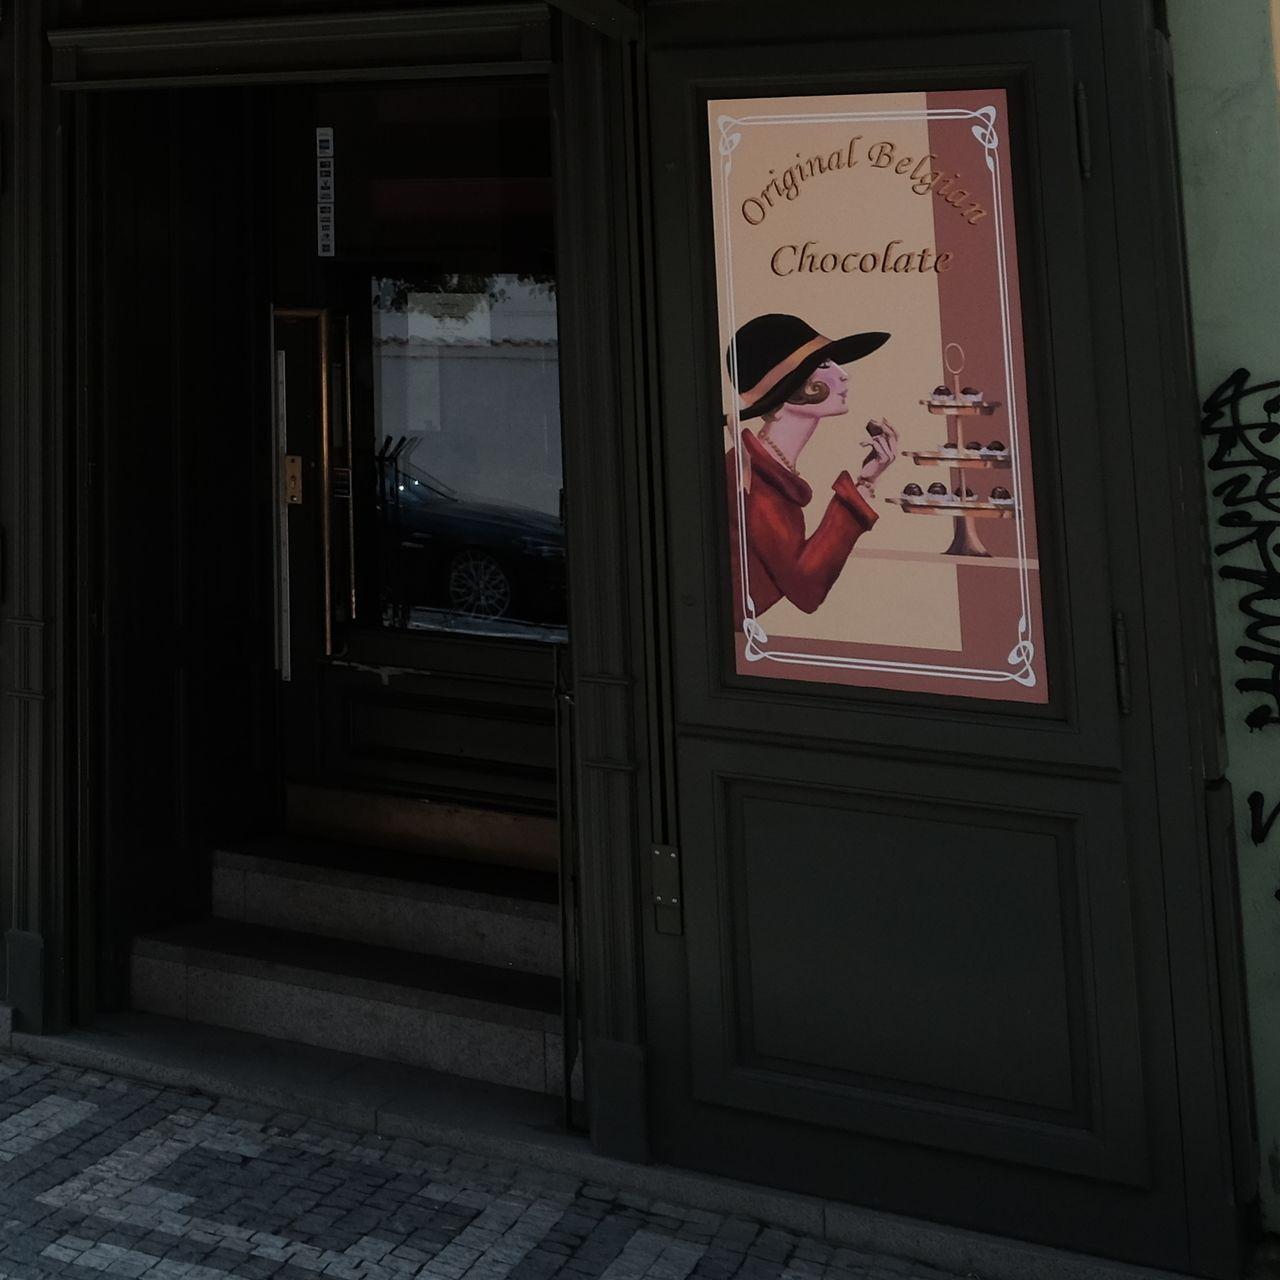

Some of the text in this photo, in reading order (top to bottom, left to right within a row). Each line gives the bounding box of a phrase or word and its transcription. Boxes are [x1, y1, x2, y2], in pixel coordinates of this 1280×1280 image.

[741, 135, 988, 226] Original Belgian
[770, 239, 954, 278] Chocolate
